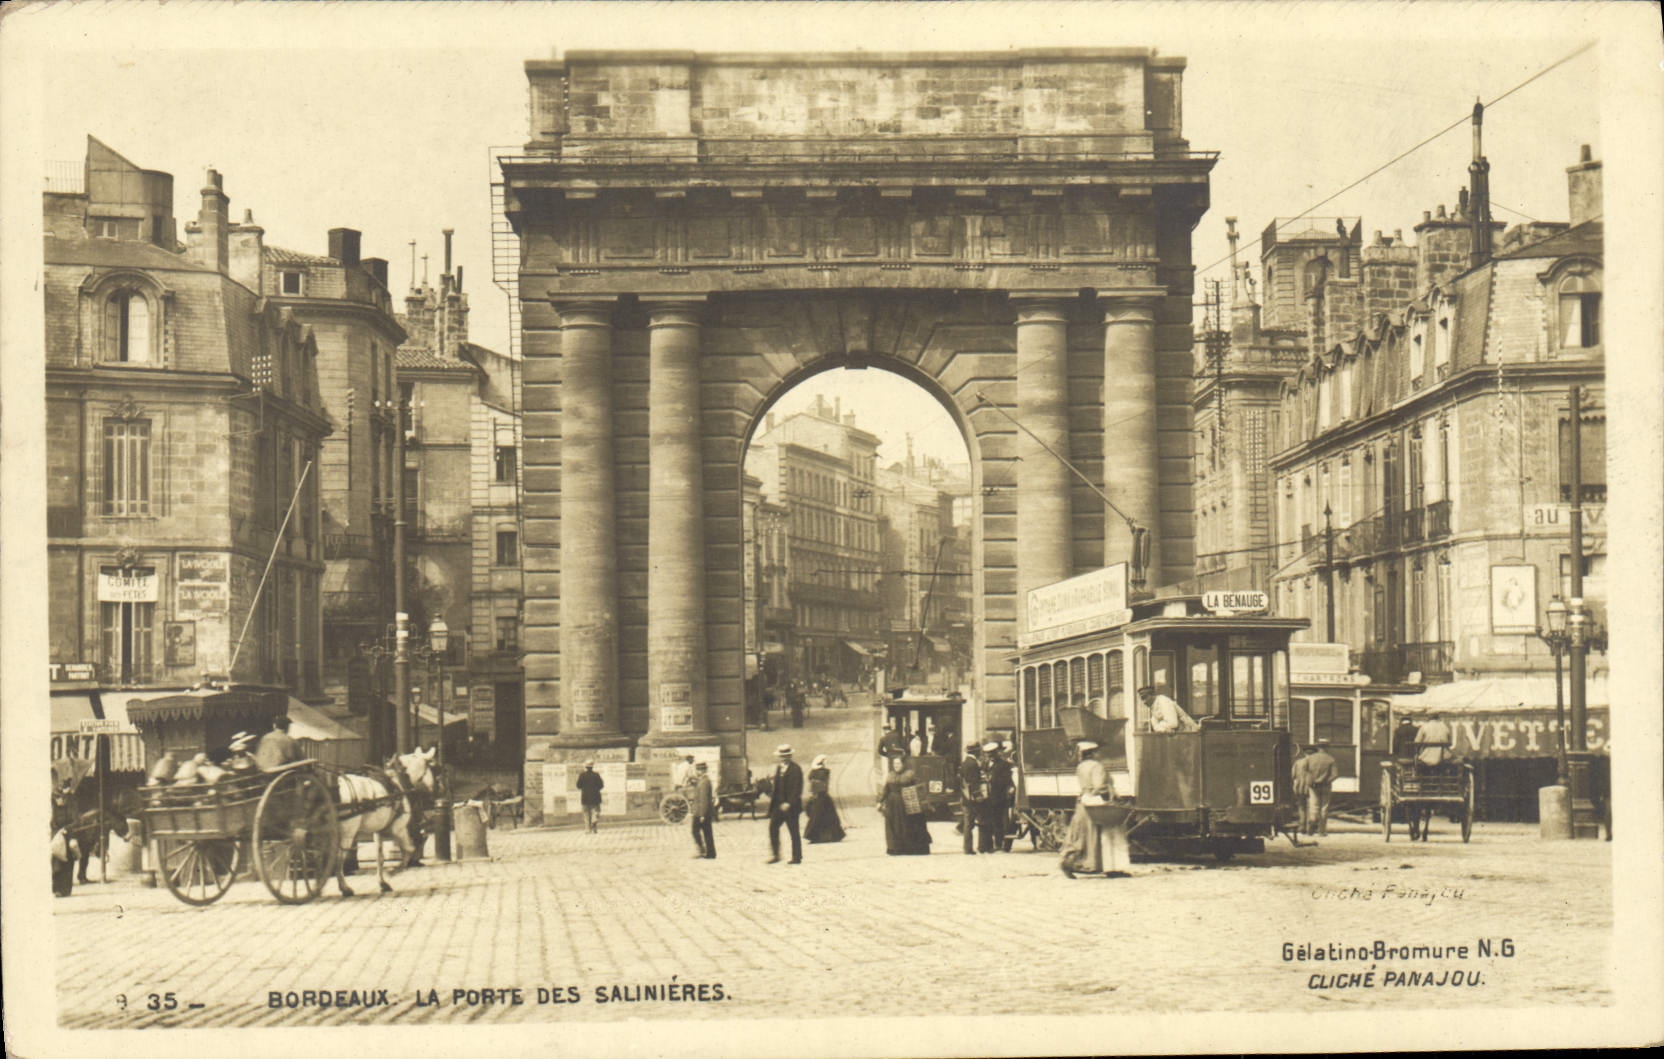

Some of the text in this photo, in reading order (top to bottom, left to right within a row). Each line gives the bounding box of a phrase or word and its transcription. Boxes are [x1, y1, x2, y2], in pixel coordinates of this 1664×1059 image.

[1534, 508, 1559, 525] au
[1207, 593, 1265, 608] LA BENAUGE
[1252, 784, 1272, 801] 99
